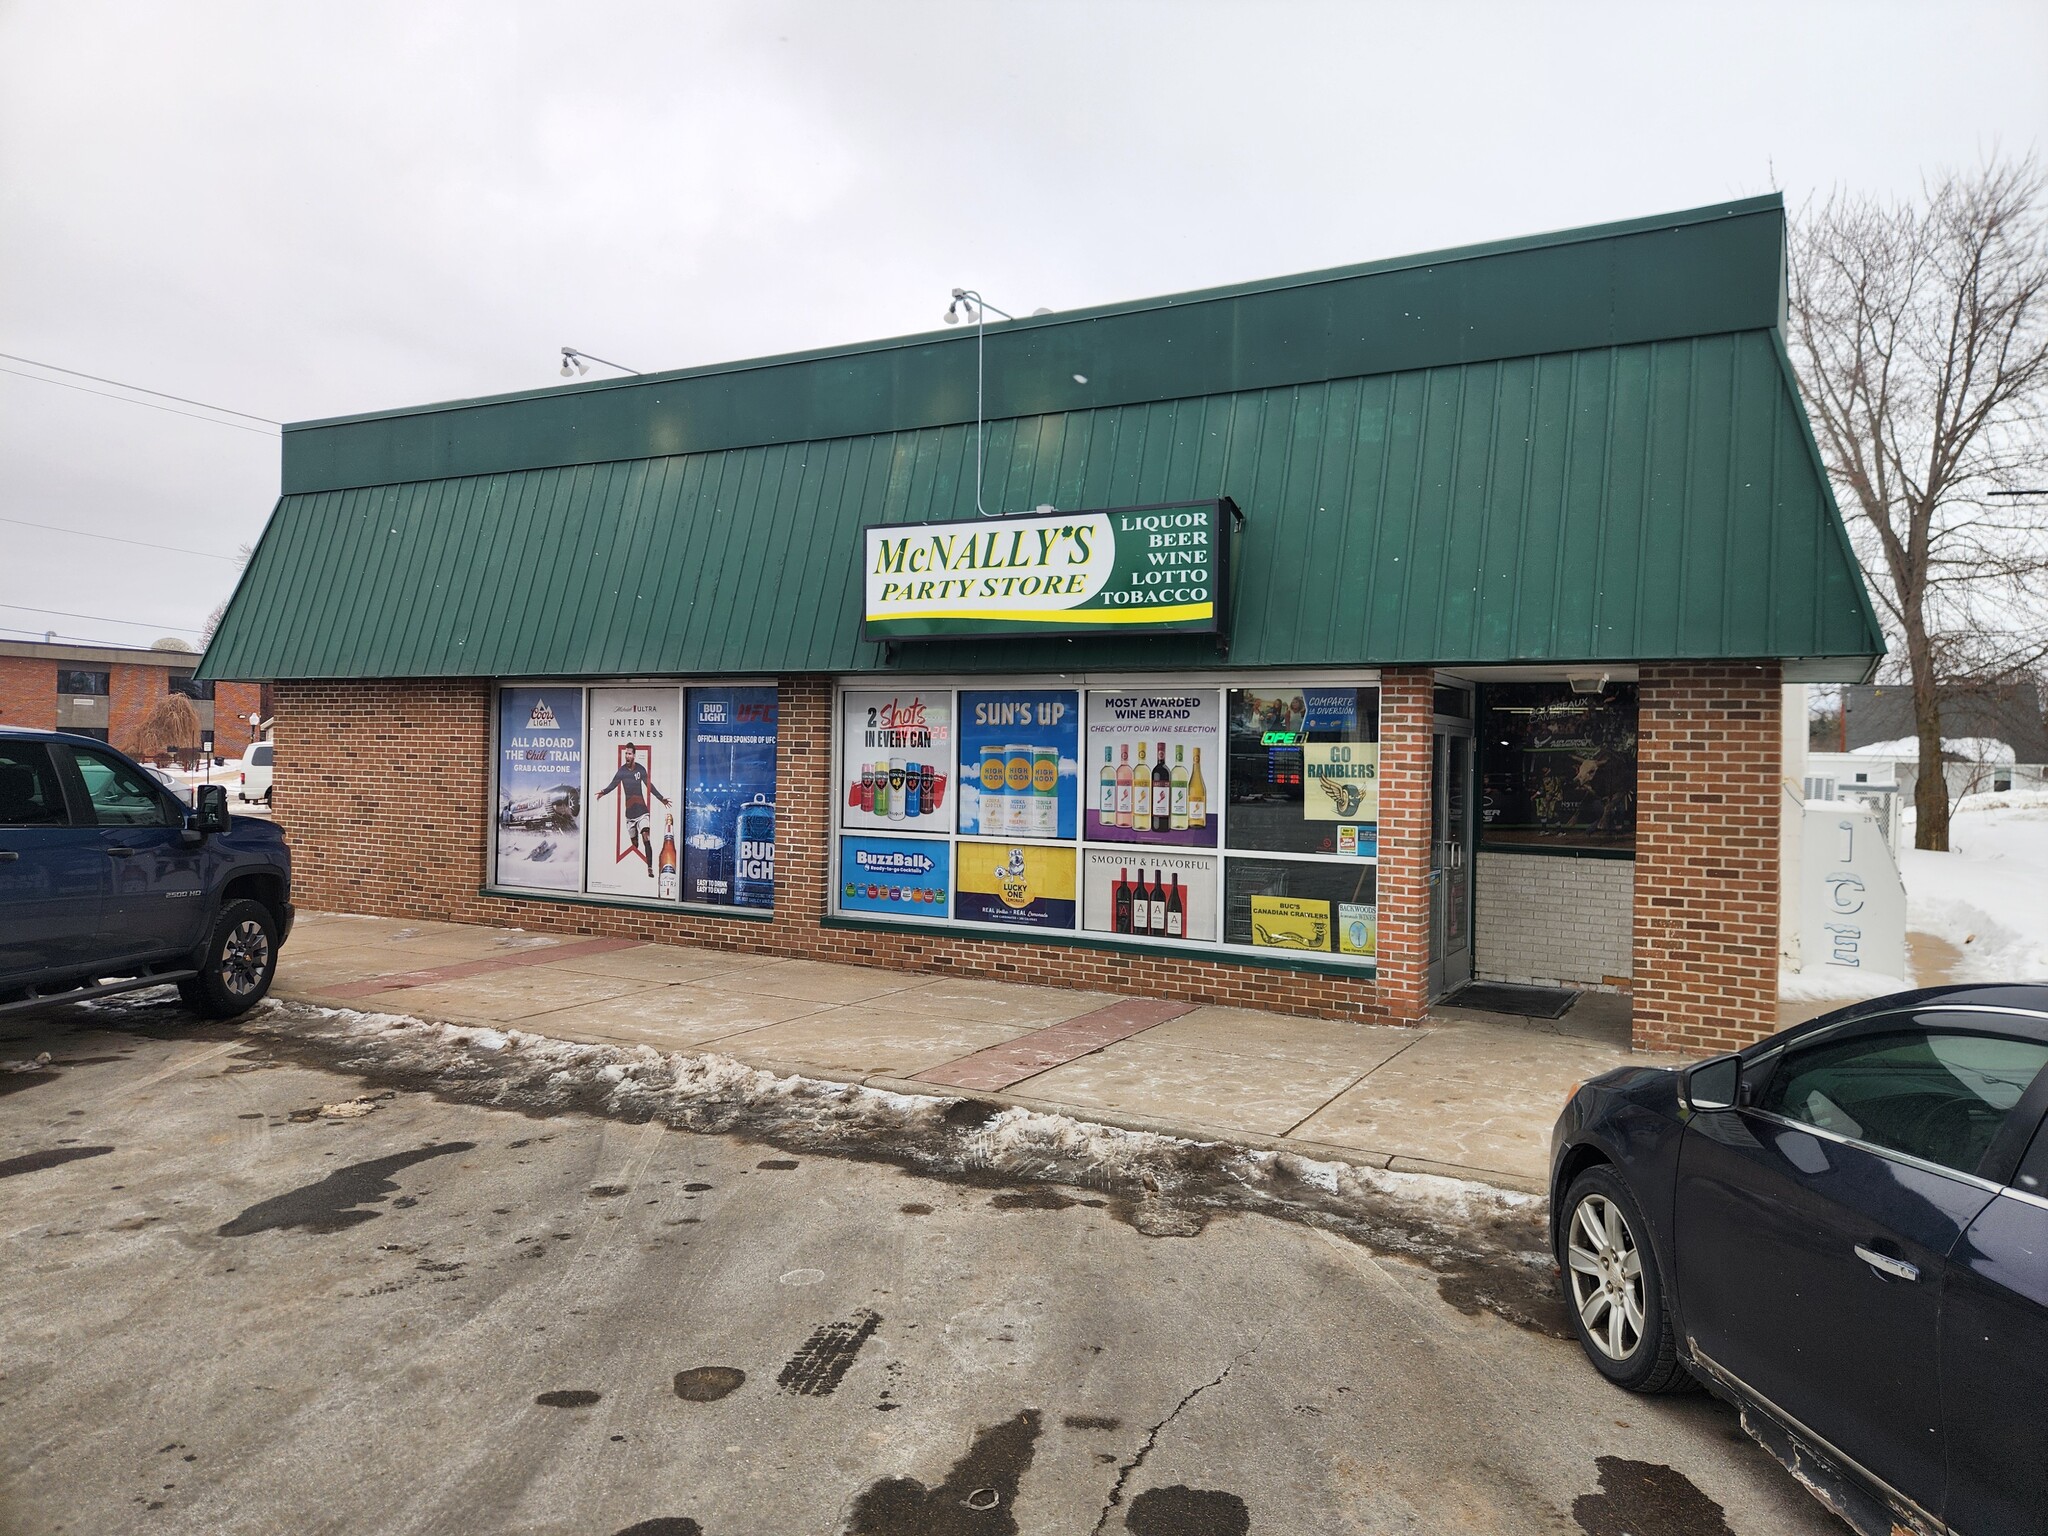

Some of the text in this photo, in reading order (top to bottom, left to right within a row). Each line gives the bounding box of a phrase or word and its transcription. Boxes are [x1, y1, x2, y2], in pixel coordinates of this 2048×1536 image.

[1121, 511, 1208, 532] LIQUOR
[1149, 531, 1208, 549] BEER
[874, 524, 1096, 575] McNALLY'S
[1147, 550, 1208, 567] WINE
[1131, 568, 1208, 586] LOTTO
[879, 573, 1088, 602] PARTY STORE
[1100, 587, 1208, 605] TOBACCO
[1105, 697, 1201, 708] MOST AWARDED
[1308, 696, 1355, 707] COMPARTE
[531, 707, 554, 720] Coors
[637, 705, 657, 713] ULTRA
[703, 703, 723, 713] BUD
[736, 703, 778, 723] UFC
[699, 713, 727, 722] LIGHT
[867, 707, 877, 728] 2
[975, 702, 1065, 726] SUN'S UP
[1114, 709, 1191, 719] WINE BRAND
[609, 718, 662, 726] UNITED BY
[607, 730, 664, 738] GREATNESS
[1090, 725, 1217, 734] CHECK OUT OUR WINE SELECTION
[511, 737, 575, 748] ALL ABOARD
[697, 734, 777, 745] OFFICIAL BEER SPONSOR OF UFC
[865, 730, 932, 748] IN EVERY CAN
[505, 749, 580, 762] THE Chill TRAIN
[1330, 745, 1352, 763] GO
[513, 764, 532, 772] GRAB
[537, 765, 555, 773] COLD
[555, 765, 571, 773] ONE
[984, 767, 1003, 775] HIGH
[1009, 767, 1028, 775] HIGH
[1307, 763, 1375, 779] RAMBLERS
[634, 771, 641, 781] 10
[741, 841, 775, 861] BUD
[857, 851, 935, 871] BuzzBallz
[1091, 854, 1211, 871] SMOOTH & FLAVORFUL
[737, 860, 774, 880] LIGH
[696, 878, 708, 886] EASY
[708, 879, 714, 887] TO
[1003, 883, 1028, 892] LUCKY
[165, 891, 188, 899] 2500
[696, 885, 708, 893] EASY
[707, 886, 714, 894] TO
[1007, 891, 1024, 899] ONE
[1279, 902, 1301, 910] BUC'S
[1339, 904, 1377, 914] BACKWOODS
[1253, 908, 1329, 920] CANADIAN CRAWLERS
